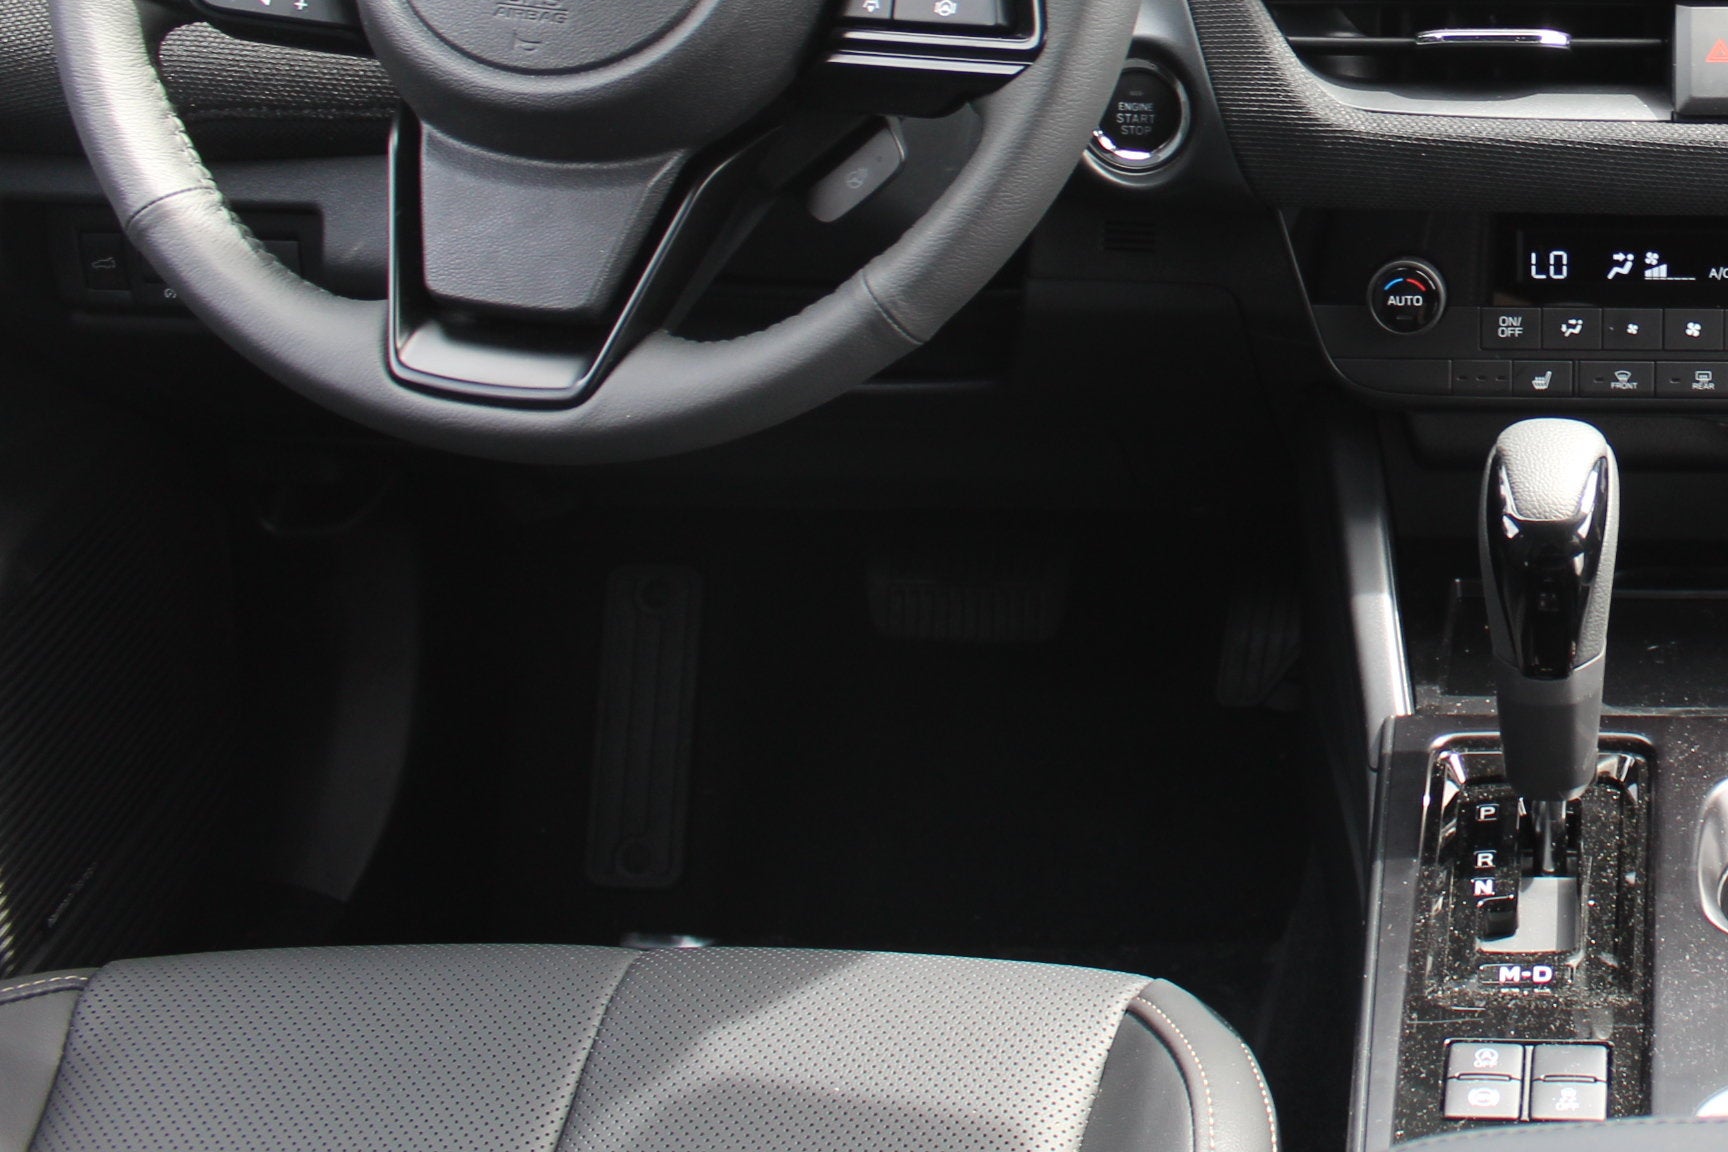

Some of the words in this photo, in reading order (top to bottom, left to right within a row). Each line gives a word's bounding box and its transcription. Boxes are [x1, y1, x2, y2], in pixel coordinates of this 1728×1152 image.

[493, 6, 568, 24] AIRBAG
[1118, 102, 1153, 111] ENGINE
[1116, 113, 1154, 124] START
[1121, 125, 1152, 135] STOP
[1387, 295, 1423, 307] AUTO
[1499, 316, 1522, 327] ON/
[1497, 327, 1524, 338] OFF
[1610, 382, 1638, 390] FRONT
[1691, 382, 1715, 390] REAR
[1479, 805, 1495, 821] P
[1476, 852, 1494, 868] R
[1474, 879, 1494, 896] N
[1473, 1060, 1498, 1069] OFF
